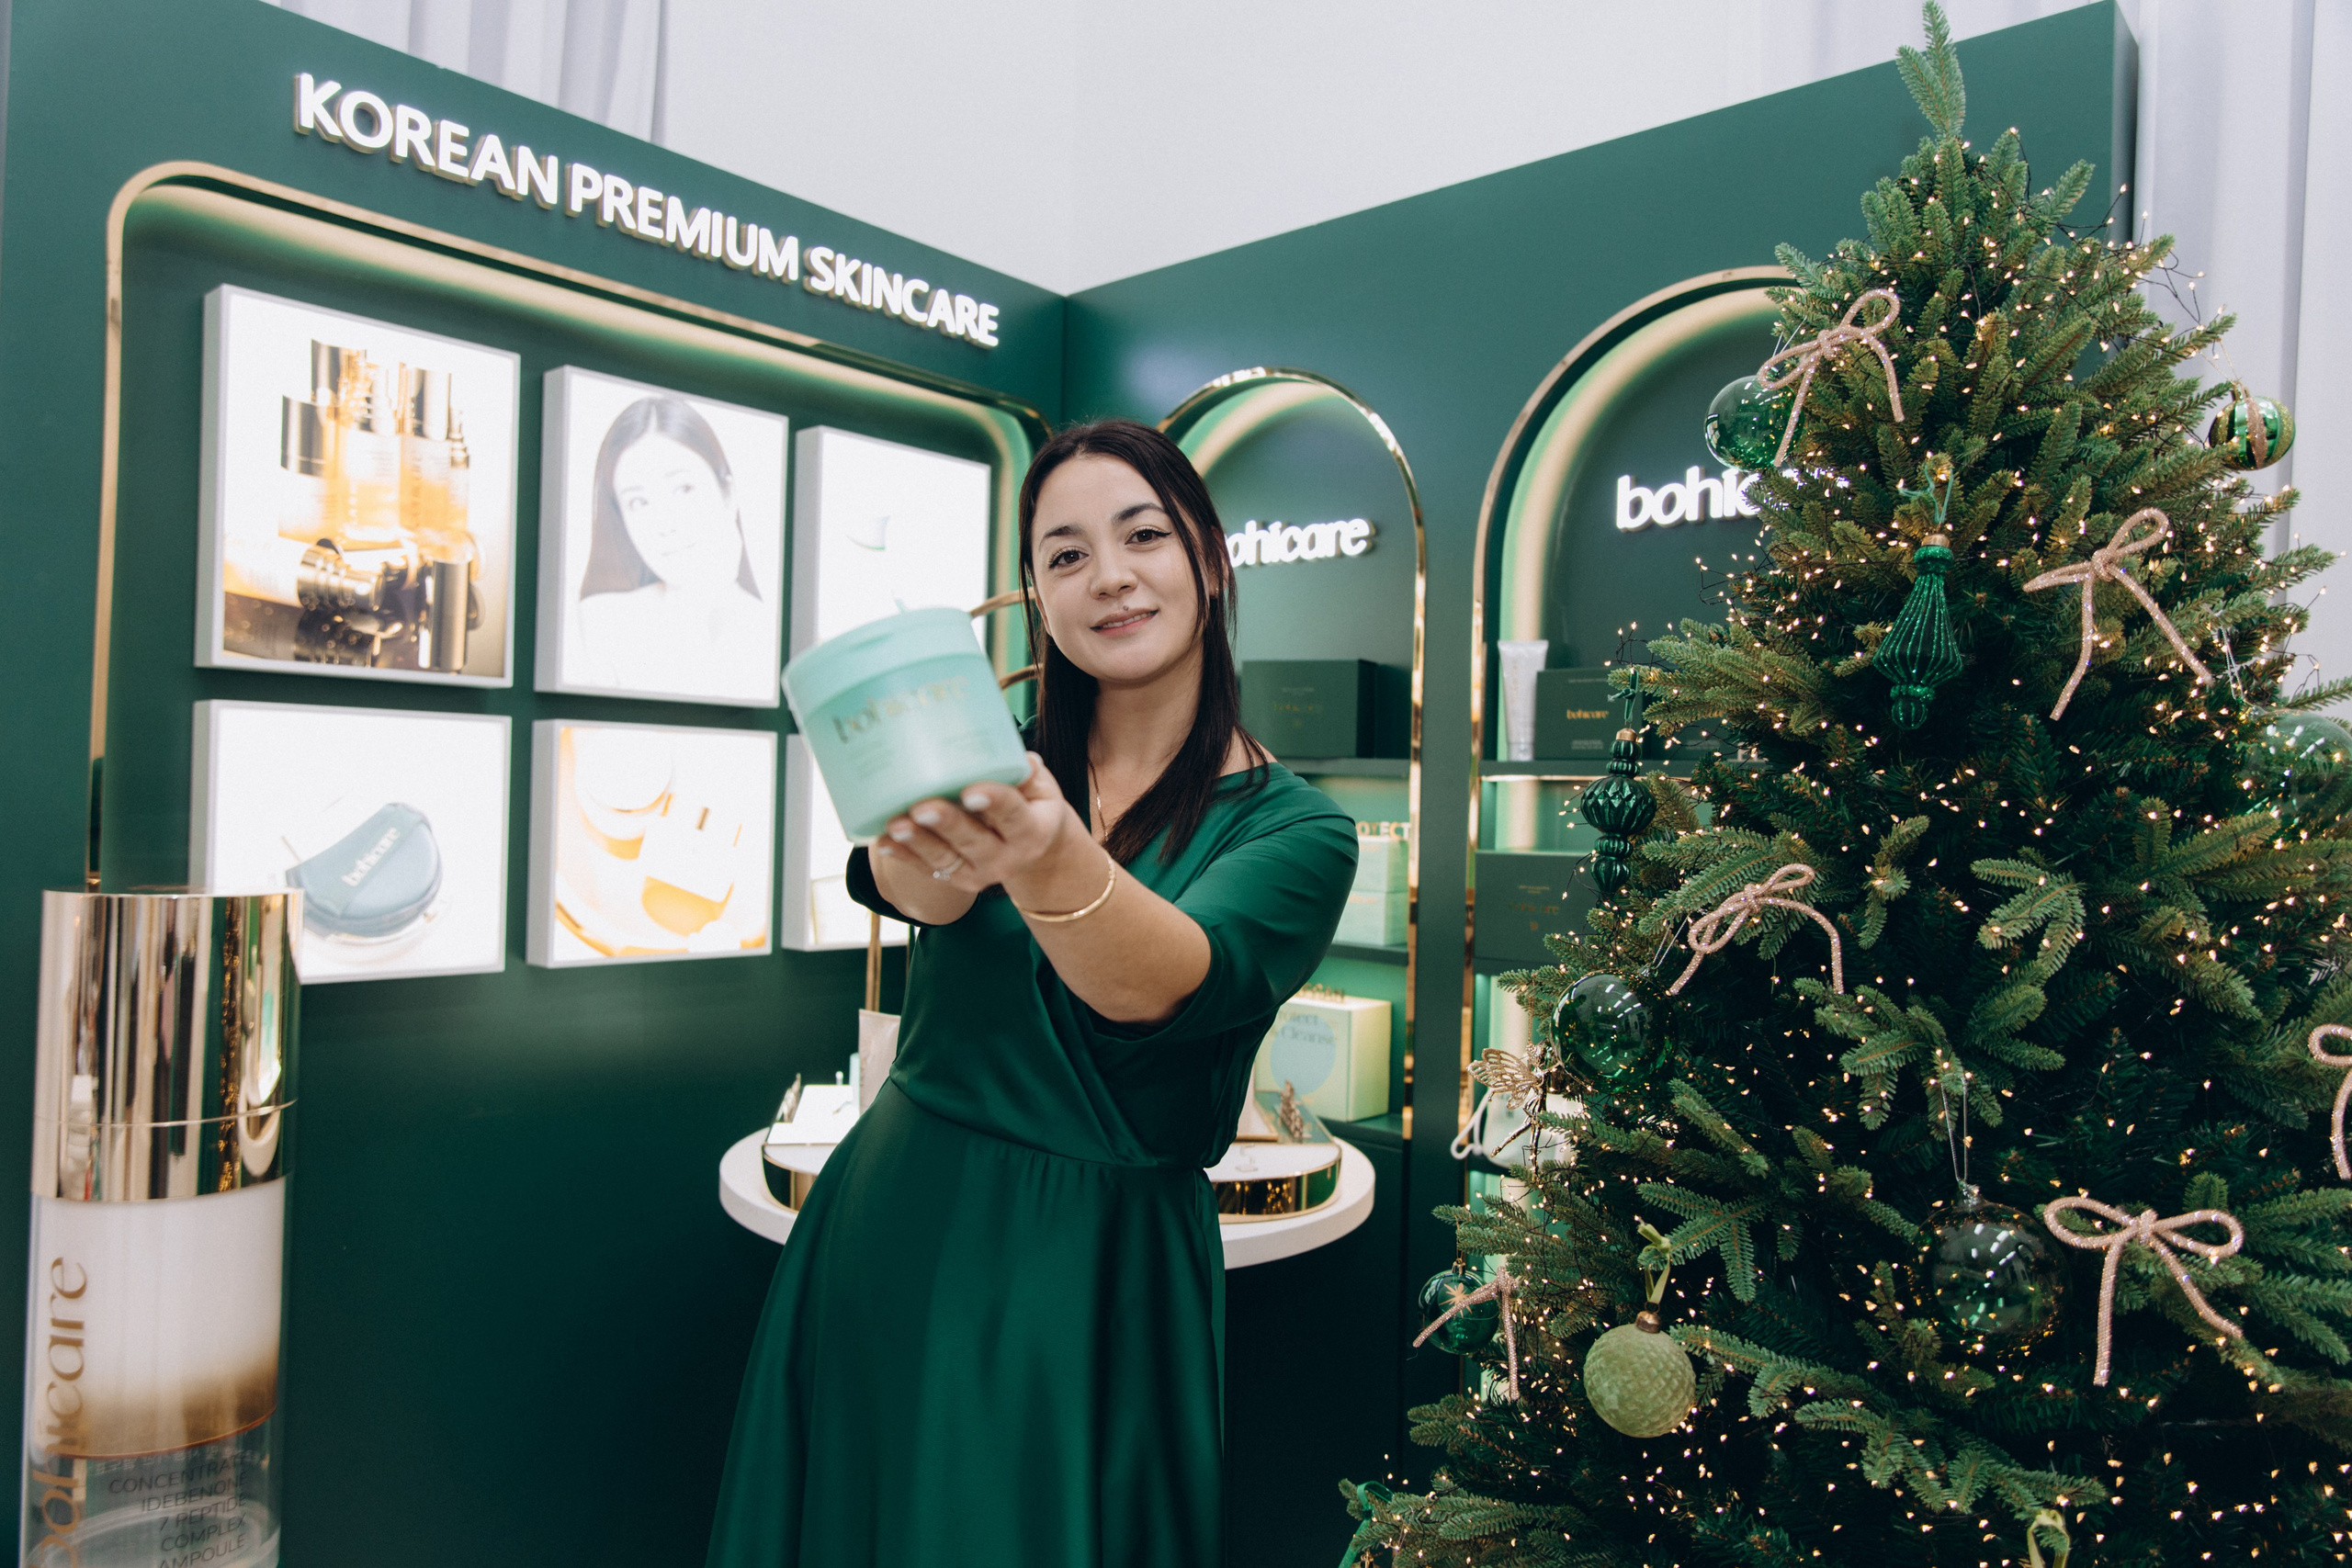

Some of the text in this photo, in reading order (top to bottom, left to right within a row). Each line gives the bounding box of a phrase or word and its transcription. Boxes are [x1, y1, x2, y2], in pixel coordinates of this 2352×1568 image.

[296, 72, 1000, 348] KOREAN PREMIUM SKINCARE
[1615, 465, 1849, 530] bohic
[1225, 517, 1372, 568] ohicare
[108, 1449, 248, 1494] CONCENTRATE
[141, 1471, 249, 1512] IDEBENONE
[161, 1512, 246, 1551] COMPLEX
[175, 1492, 249, 1528] PEPTIDE
